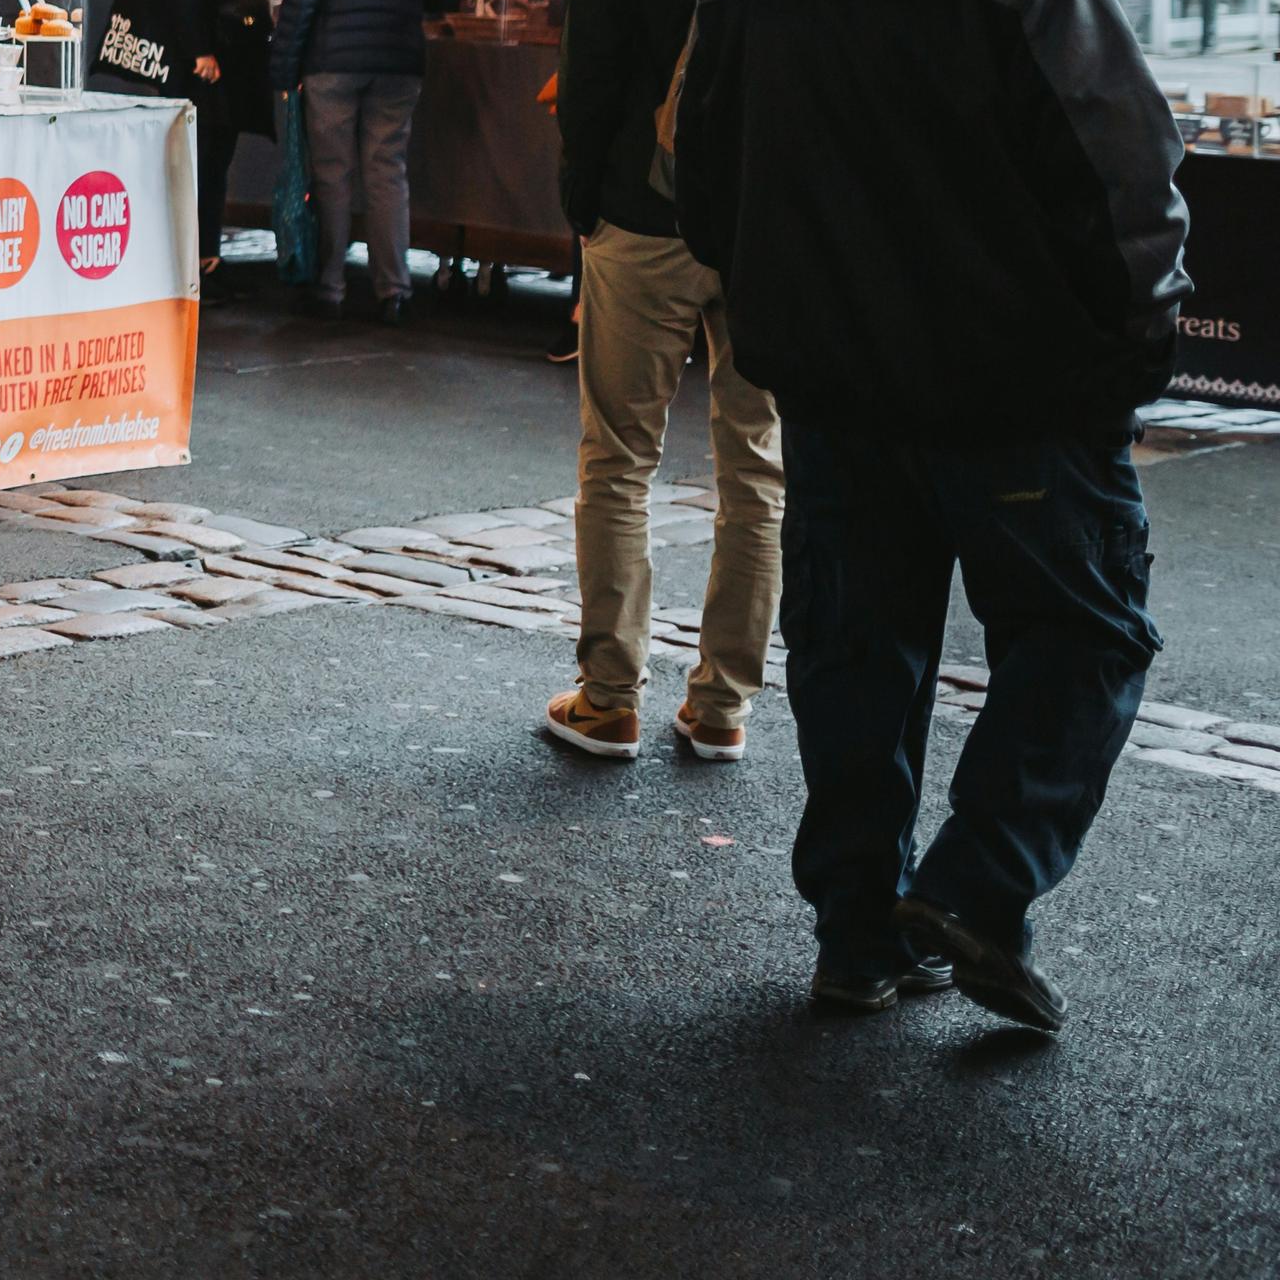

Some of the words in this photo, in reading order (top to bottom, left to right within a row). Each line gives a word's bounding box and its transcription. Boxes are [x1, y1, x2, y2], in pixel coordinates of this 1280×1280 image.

[111, 13, 131, 33] the
[100, 44, 170, 83] MUSEUM
[104, 29, 164, 62] DESIGN
[63, 194, 88, 231] NO
[91, 191, 128, 228] CANE
[70, 231, 121, 270] SUGAR
[40, 344, 55, 373] IN
[63, 342, 71, 371] A
[77, 331, 145, 369] DEDICATED
[43, 374, 77, 407] FREE
[78, 365, 146, 401] PREMISES
